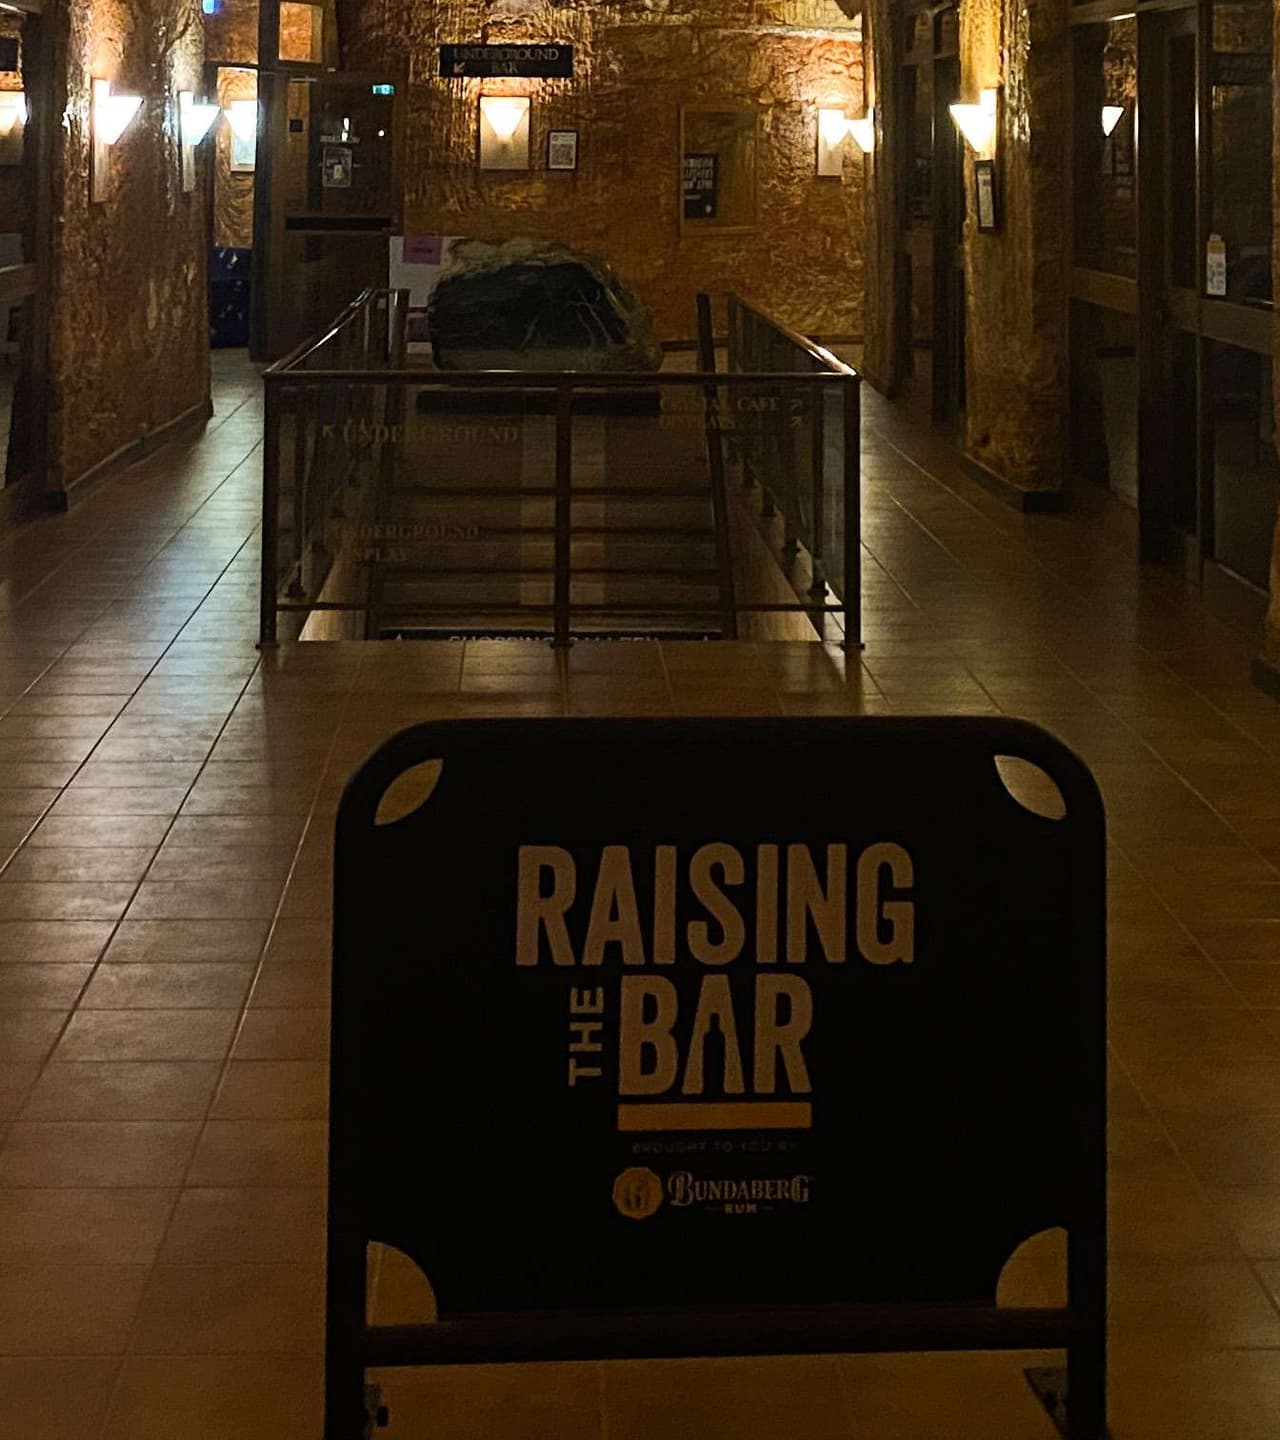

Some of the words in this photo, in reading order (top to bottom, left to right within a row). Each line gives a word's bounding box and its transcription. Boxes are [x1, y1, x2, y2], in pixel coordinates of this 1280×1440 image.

[343, 423, 519, 443] UNDEGROUND
[516, 842, 915, 966] RAISING
[568, 987, 604, 1087] THE
[618, 973, 813, 1095] BAR
[631, 1140, 705, 1155] BROUGHT
[711, 1140, 733, 1153] TO
[741, 1139, 770, 1153] YOU
[666, 1169, 811, 1207] BUNDABERG
[723, 1203, 759, 1215] RUM
